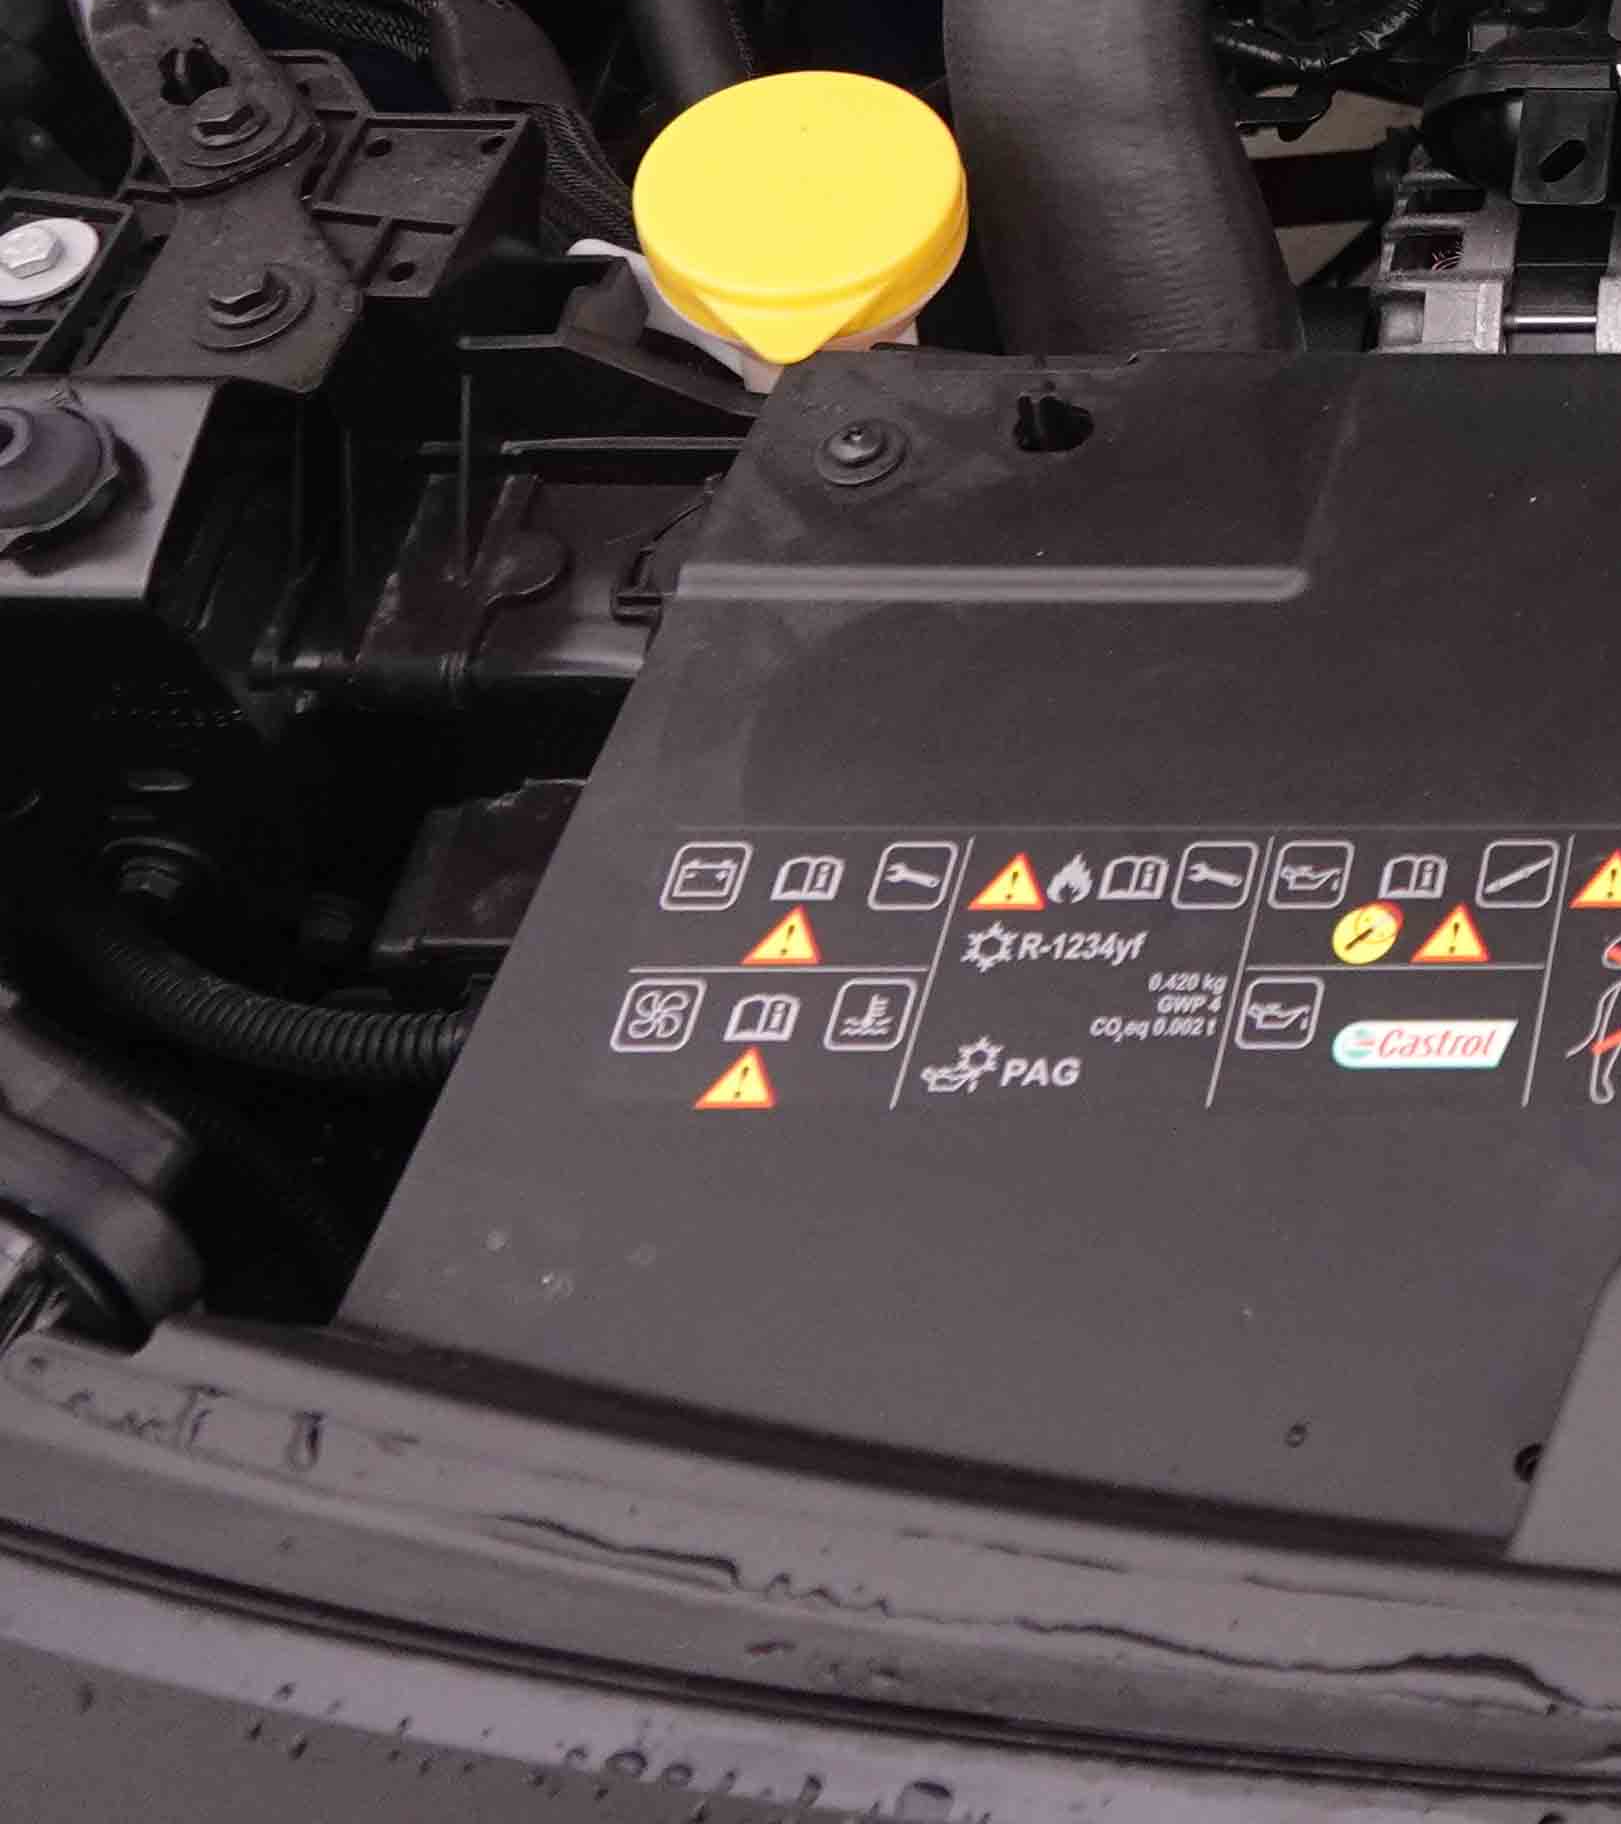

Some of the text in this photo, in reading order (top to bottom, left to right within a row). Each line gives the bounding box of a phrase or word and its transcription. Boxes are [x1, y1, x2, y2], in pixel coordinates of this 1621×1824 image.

[1017, 931, 1148, 966] R-1234yf
[1201, 973, 1229, 995] kg
[1157, 994, 1223, 1014] GWP 4
[1378, 1028, 1497, 1058] Castrol
[1000, 1057, 1082, 1088] PAG
